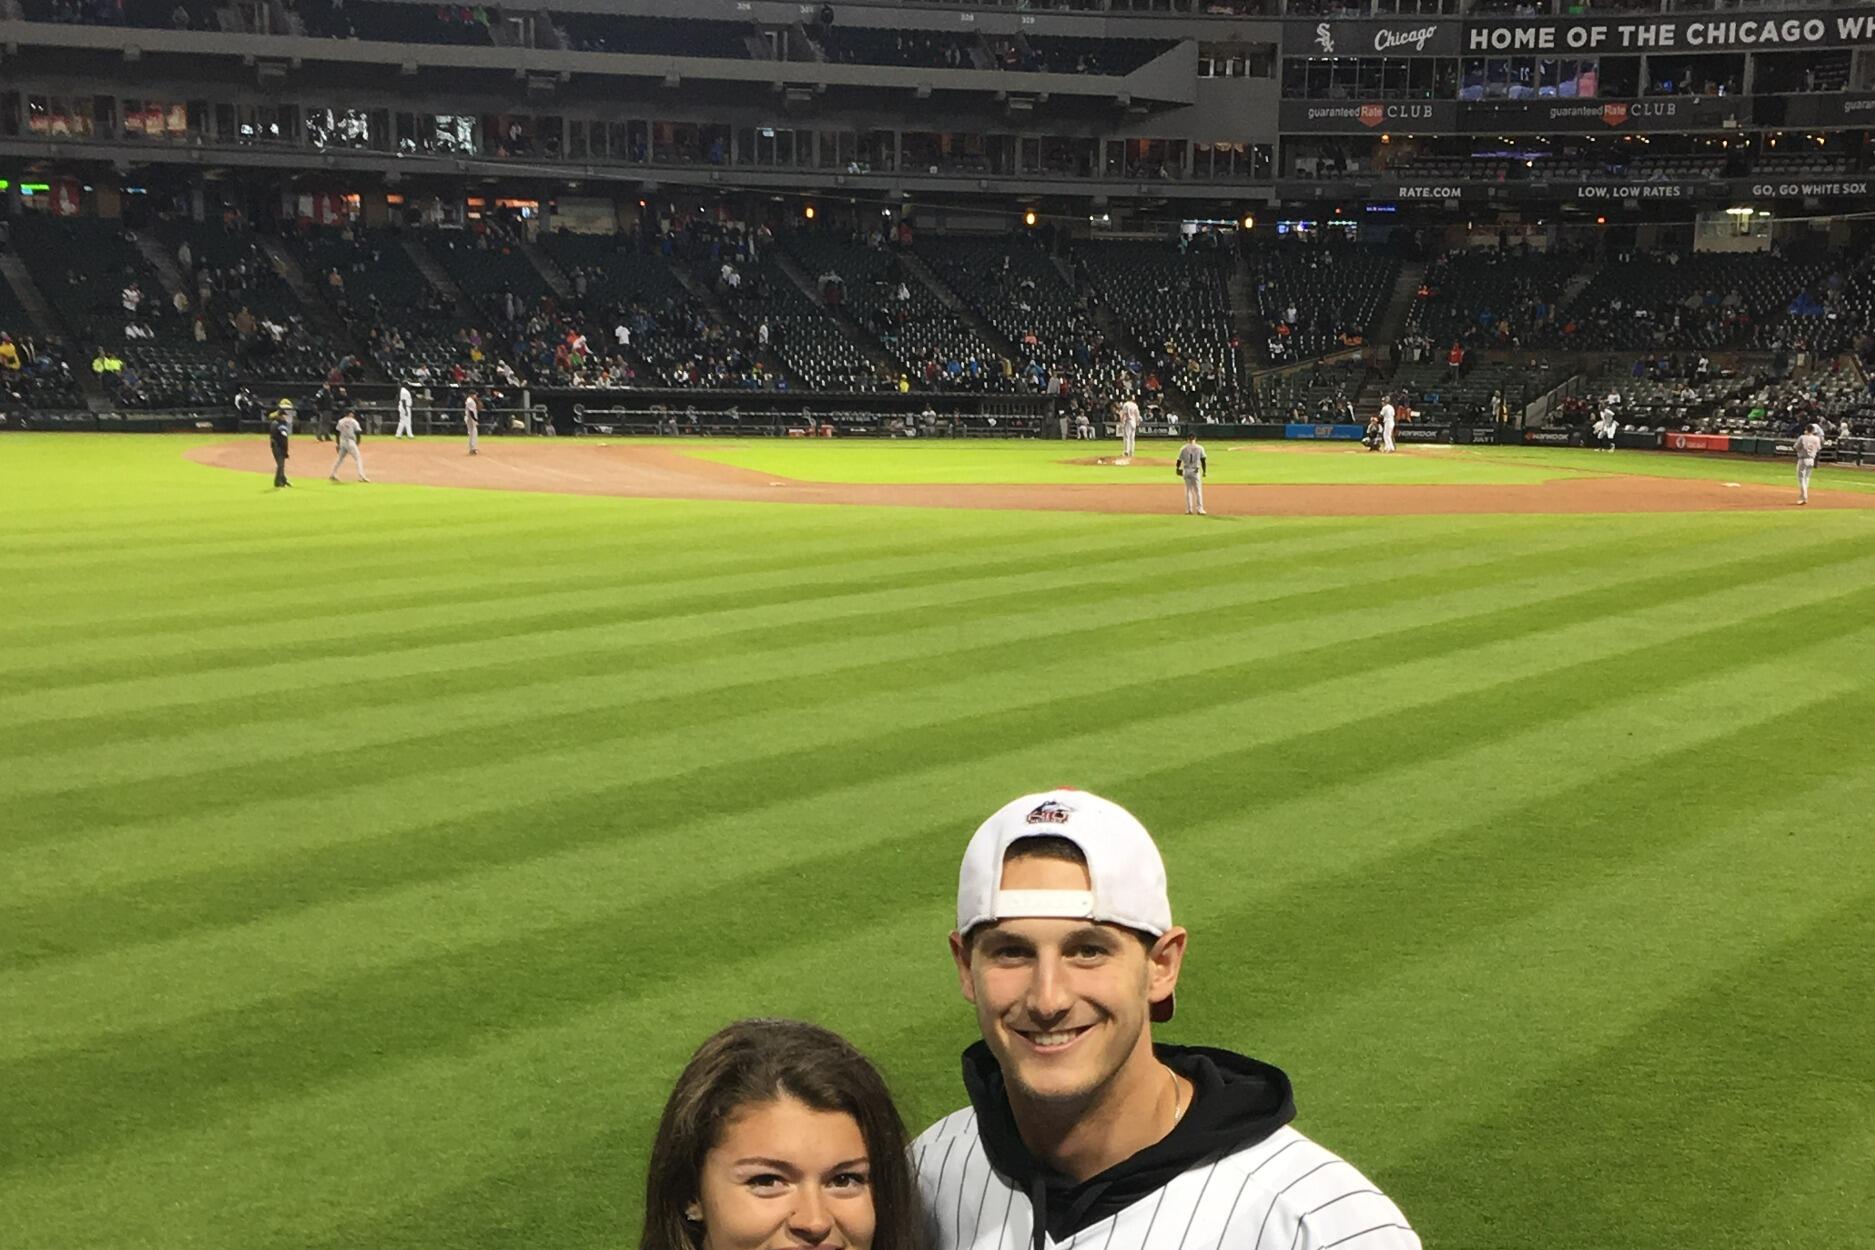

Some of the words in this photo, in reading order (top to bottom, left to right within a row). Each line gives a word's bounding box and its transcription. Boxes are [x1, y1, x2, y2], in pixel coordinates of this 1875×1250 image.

[1374, 25, 1438, 51] Chicago
[1470, 27, 1556, 50] HOME
[1566, 26, 1607, 48] OF
[1618, 24, 1676, 47] THE
[1686, 19, 1825, 46] CHICAGO
[1307, 106, 1360, 119] guaranteed
[1361, 106, 1383, 117] Rate
[1387, 105, 1433, 118] CLUB
[1549, 105, 1603, 119] guaranteed
[1630, 103, 1677, 116] CLUB
[1399, 187, 1462, 197] RATE.COM
[1578, 187, 1610, 199] LOW,
[1613, 187, 1640, 197] LOW
[1643, 186, 1680, 197] RATES
[1752, 184, 1776, 197] GO,
[1779, 184, 1799, 195] GO
[1801, 183, 1840, 195] WHITE
[1842, 183, 1867, 194] SOX
